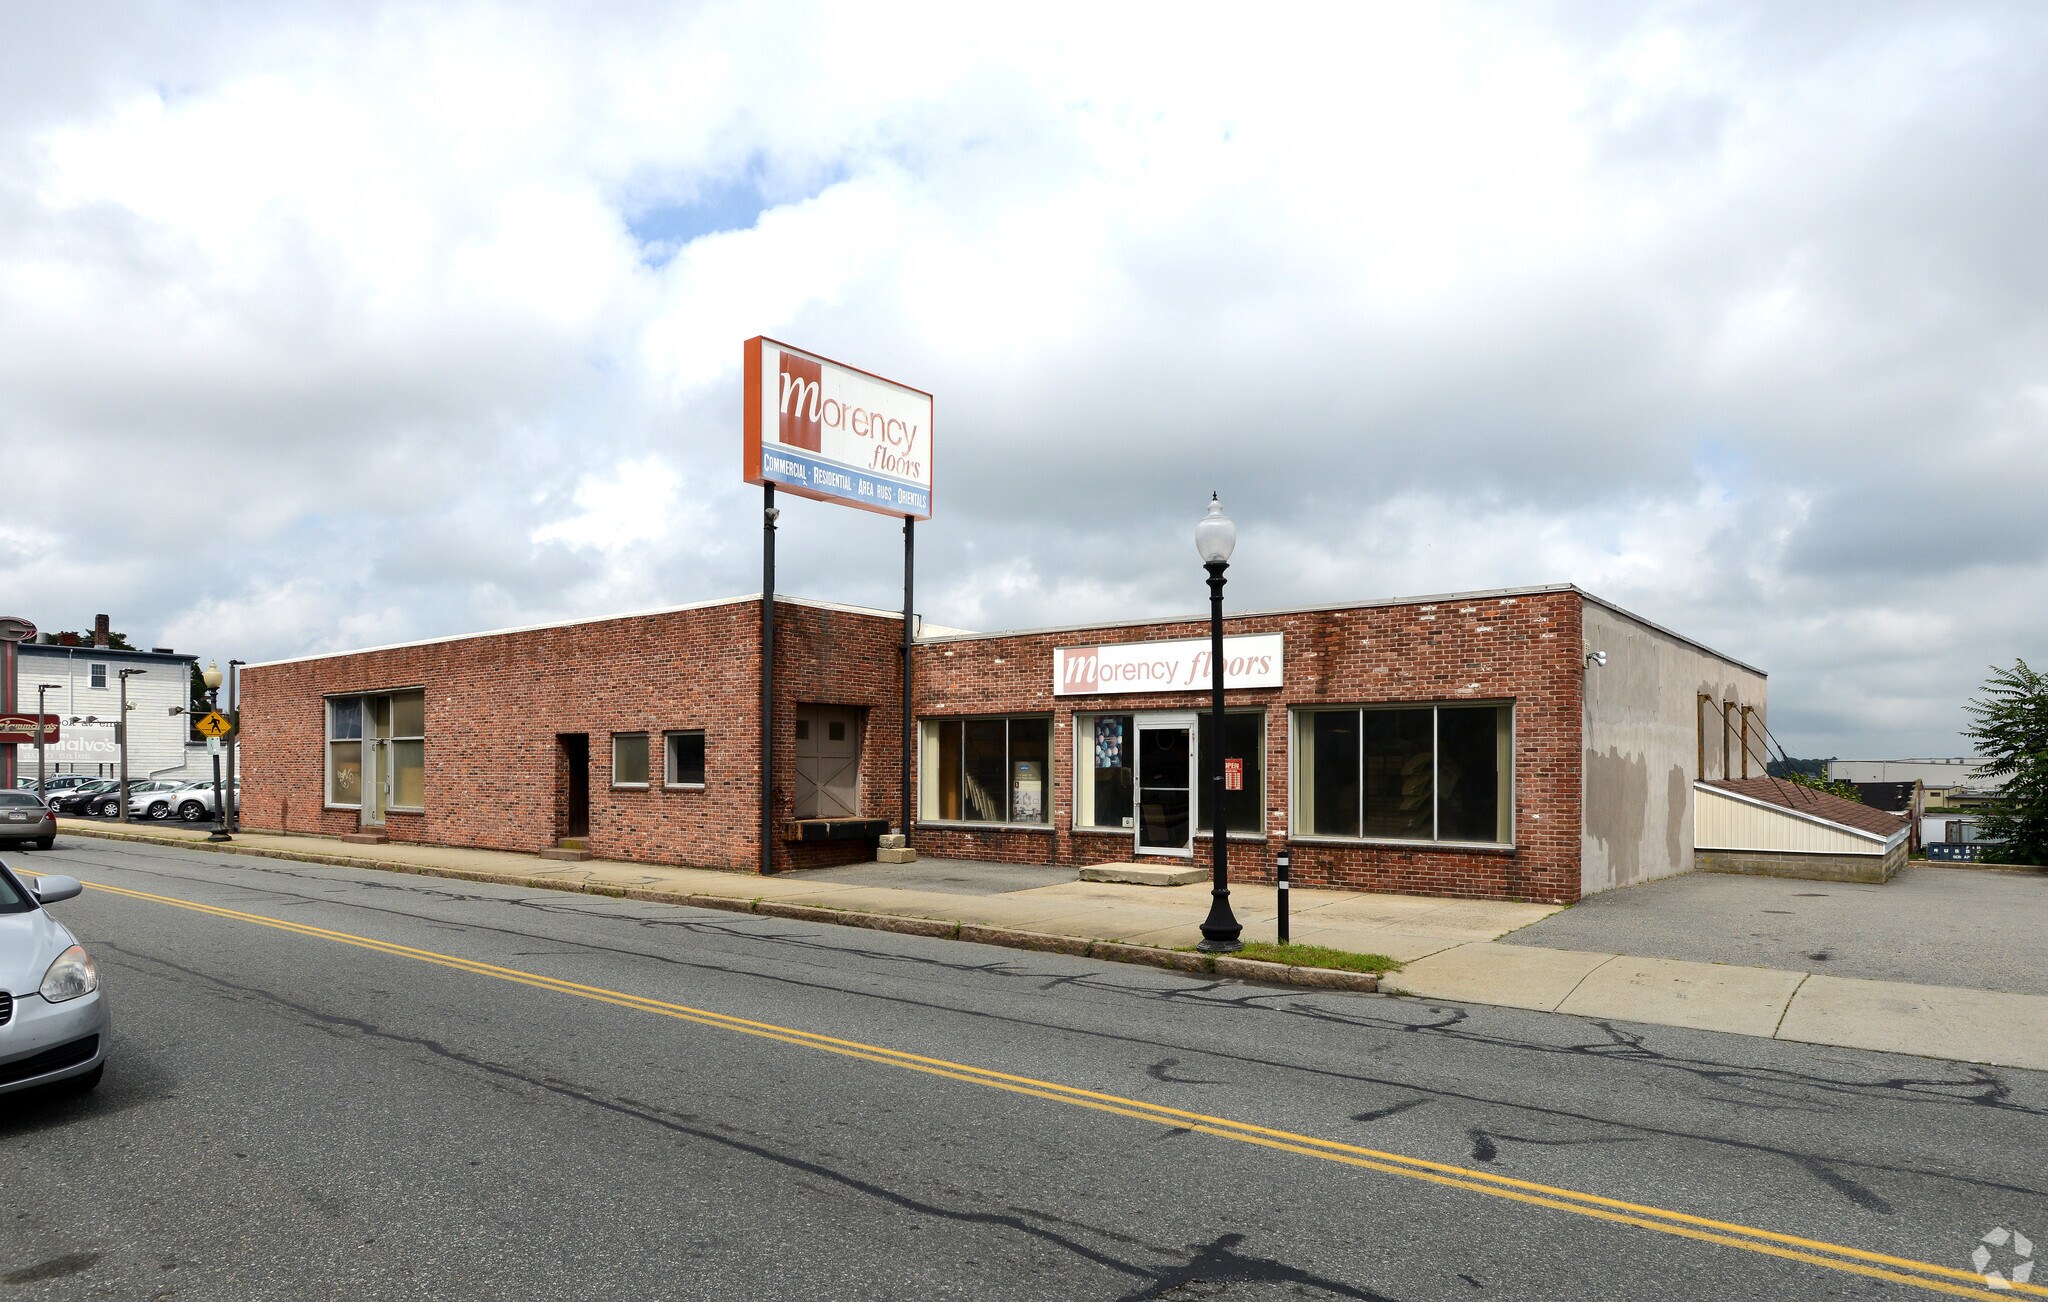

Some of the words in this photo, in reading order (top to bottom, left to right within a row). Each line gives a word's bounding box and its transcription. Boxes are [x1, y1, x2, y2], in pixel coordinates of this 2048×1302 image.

[868, 445, 921, 478] floors
[764, 453, 807, 480] COMMERCIAL
[813, 466, 852, 491] RESIDENTIAL
[858, 478, 874, 496] AREA
[877, 482, 892, 501] RUGS
[897, 488, 927, 509] ORIENTALS
[1184, 650, 1272, 685] flors
[24, 752, 54, 760] auo
[59, 752, 91, 760] sales
